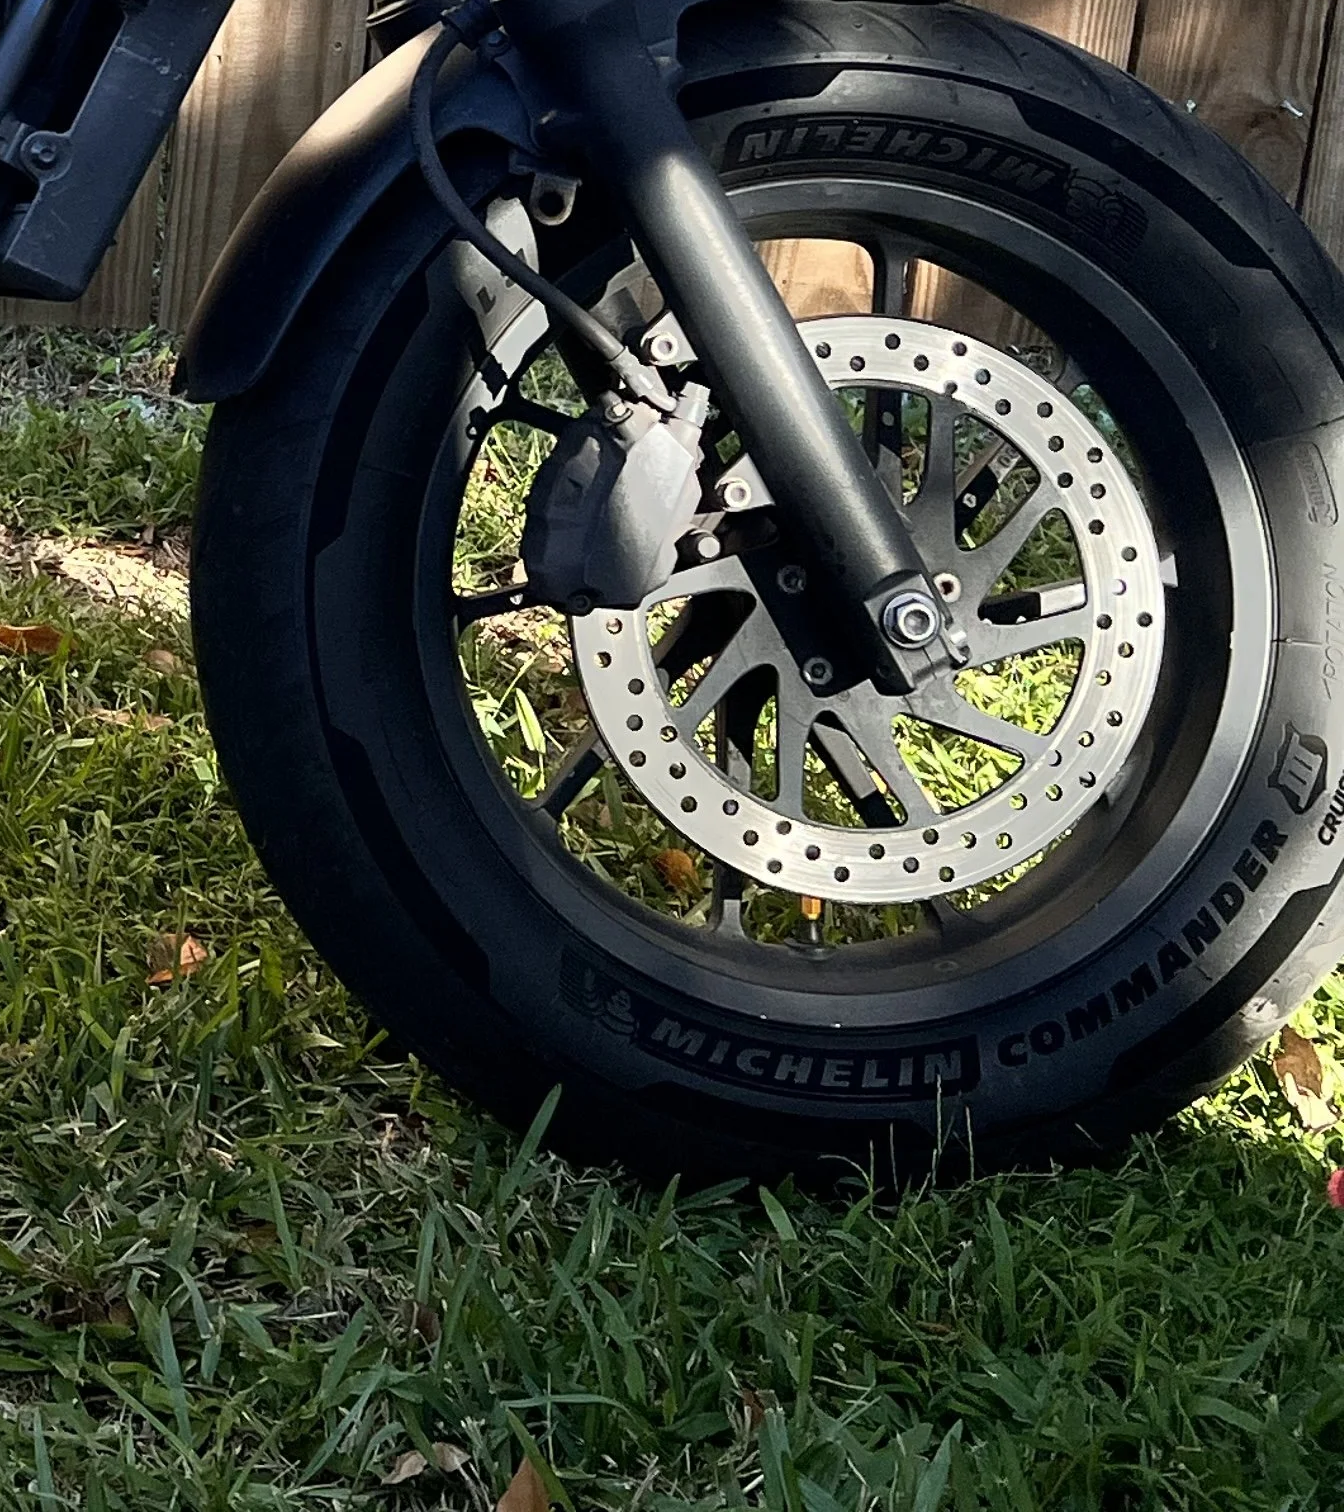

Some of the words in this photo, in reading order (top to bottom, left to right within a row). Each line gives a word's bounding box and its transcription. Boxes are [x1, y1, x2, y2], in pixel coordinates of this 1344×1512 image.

[738, 124, 1058, 193] MICHELIN
[997, 819, 1289, 1068] COMMANDER
[651, 1017, 962, 1088] MICHELIN
